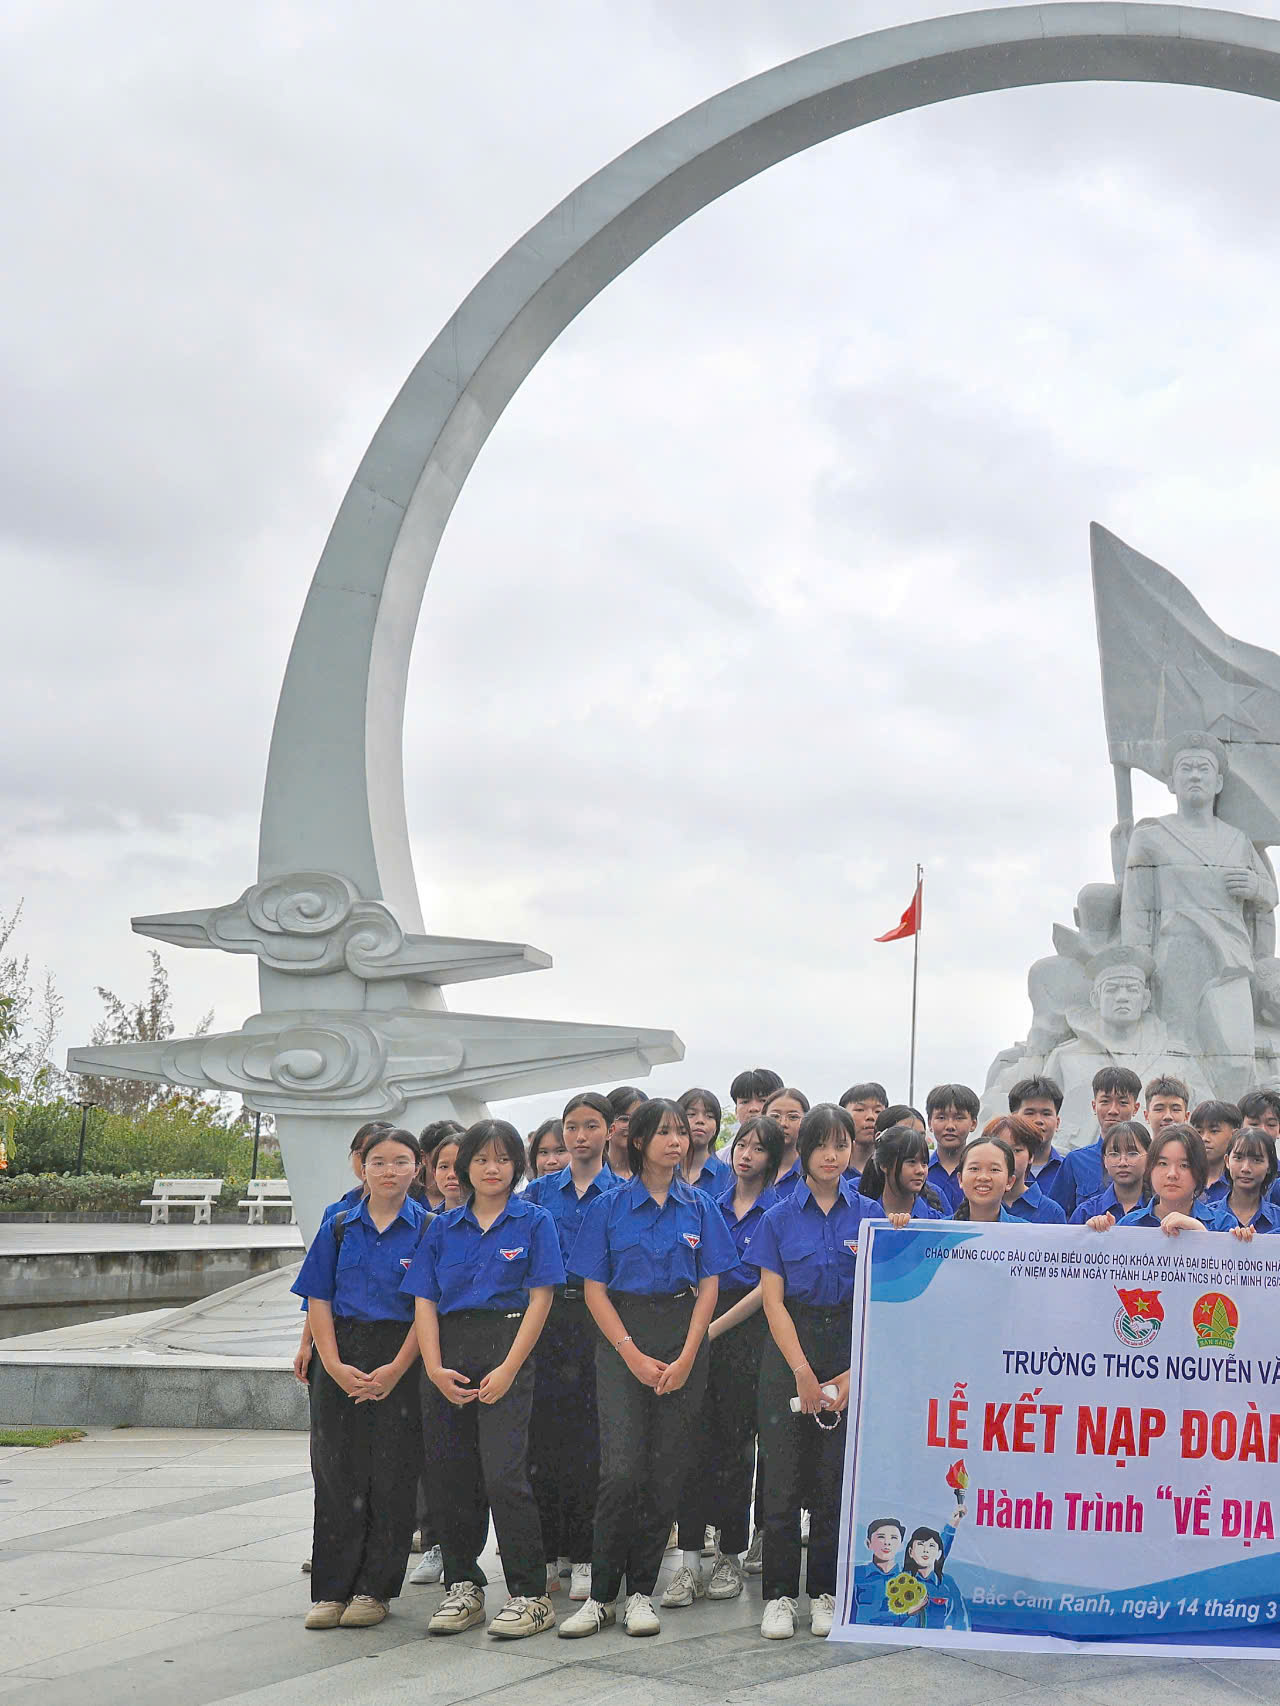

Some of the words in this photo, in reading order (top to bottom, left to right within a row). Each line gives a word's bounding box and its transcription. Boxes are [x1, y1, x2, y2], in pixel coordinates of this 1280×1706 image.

[925, 1246, 949, 1259] CHÀO
[951, 1247, 978, 1260] MỪNG
[980, 1249, 1005, 1263] CUỘC
[1007, 1249, 1026, 1262] BẦU
[1028, 1249, 1042, 1262] CỬ
[1044, 1252, 1059, 1265] ĐẠI
[1061, 1251, 1082, 1264] BIỂU
[1084, 1252, 1110, 1265] QUỐC
[1112, 1254, 1128, 1267] HỘI
[1130, 1253, 1155, 1266] KHÓA
[1157, 1256, 1171, 1267] XVI
[1173, 1254, 1185, 1267] VÀ
[1186, 1257, 1199, 1270] ĐẠI
[1201, 1256, 1219, 1269] BIỂU
[1221, 1259, 1236, 1272] HỘI
[1238, 1258, 1263, 1272] ĐỒNG
[1024, 1266, 1046, 1279] NIỆM
[1048, 1267, 1058, 1278] 95
[1060, 1266, 1080, 1279] NĂM
[1082, 1266, 1108, 1280] NGÀY
[1110, 1267, 1140, 1281] THÀNH
[1142, 1269, 1159, 1283] LẬP
[1161, 1269, 1186, 1282] ĐOÀN
[1188, 1272, 1209, 1284] TNCS
[1210, 1271, 1223, 1285] HỒ
[1225, 1273, 1239, 1285] CHÍ
[1240, 1275, 1262, 1287] MINH
[1002, 1346, 1096, 1377] TRƯỜNG
[1103, 1353, 1159, 1379] THCS
[1166, 1353, 1251, 1384] NGUYỄN
[927, 1381, 969, 1449] LỄ
[982, 1387, 1063, 1454] KẾT
[1075, 1405, 1167, 1468] NẠP
[976, 1488, 1053, 1530] Hành
[1064, 1492, 1144, 1533] Trình
[1221, 1498, 1275, 1547] ĐỊA
[971, 1585, 1007, 1606] Bắc
[1012, 1589, 1052, 1610] Cam
[1058, 1593, 1115, 1616] Ranh,
[1121, 1596, 1171, 1619] ngày
[1176, 1597, 1200, 1616] 14
[1204, 1599, 1260, 1623] tháng
[1265, 1601, 1277, 1619] 3
